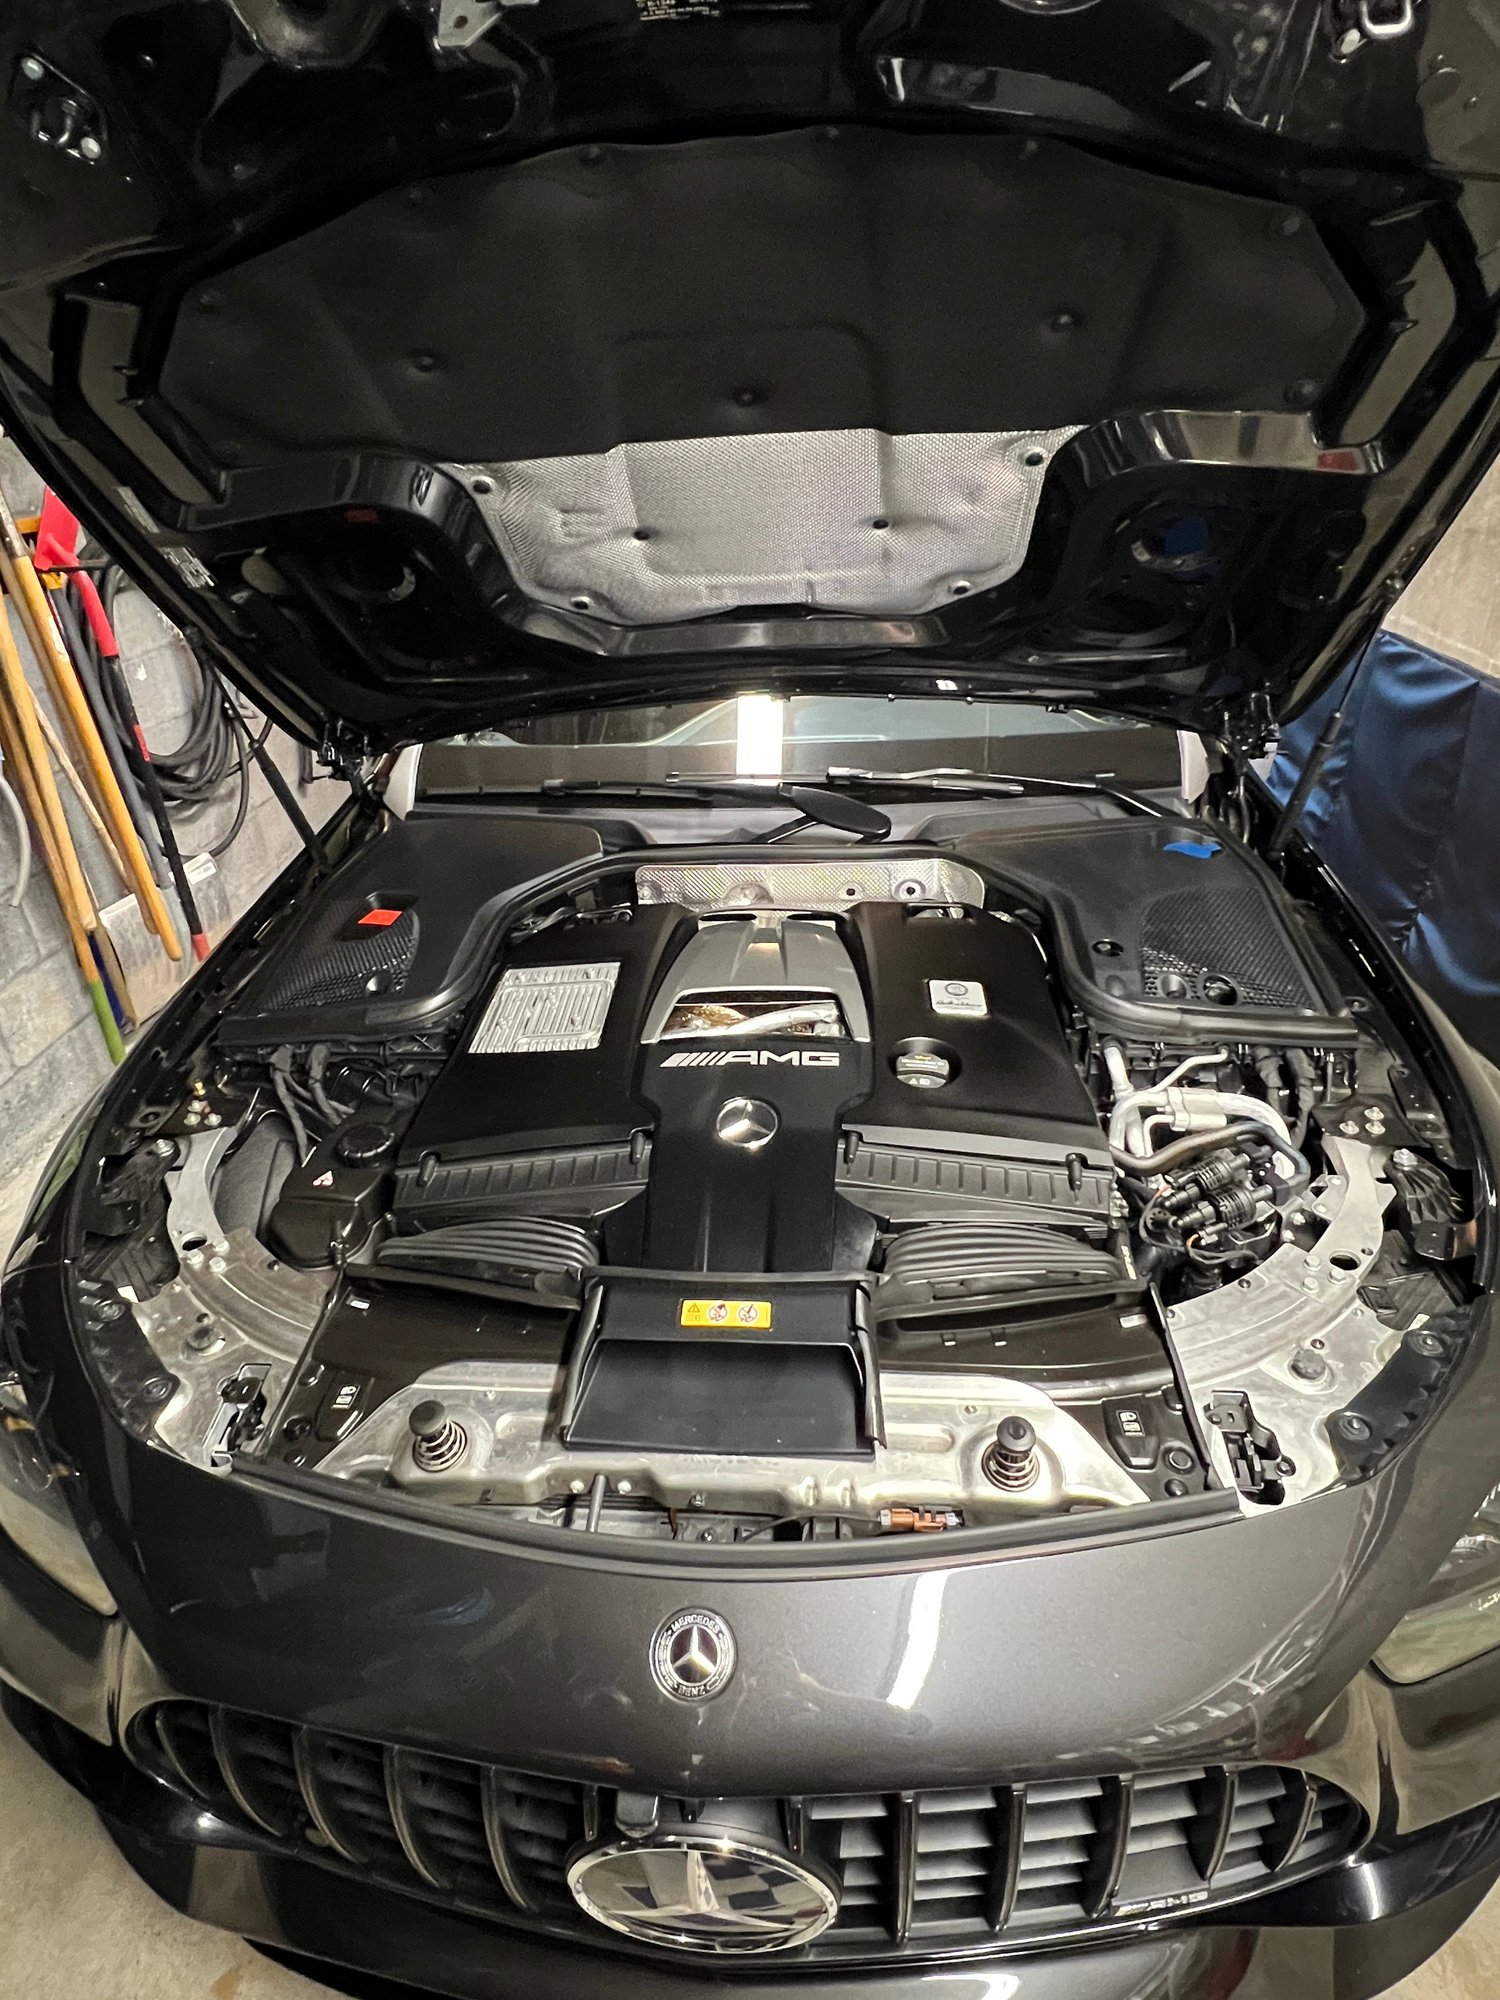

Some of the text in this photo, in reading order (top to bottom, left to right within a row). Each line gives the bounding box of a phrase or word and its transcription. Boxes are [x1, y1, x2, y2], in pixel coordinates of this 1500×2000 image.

[715, 1050, 840, 1067] AMG
[670, 1614, 721, 1635] MERCEDES
[678, 1684, 706, 1697] BENZ
